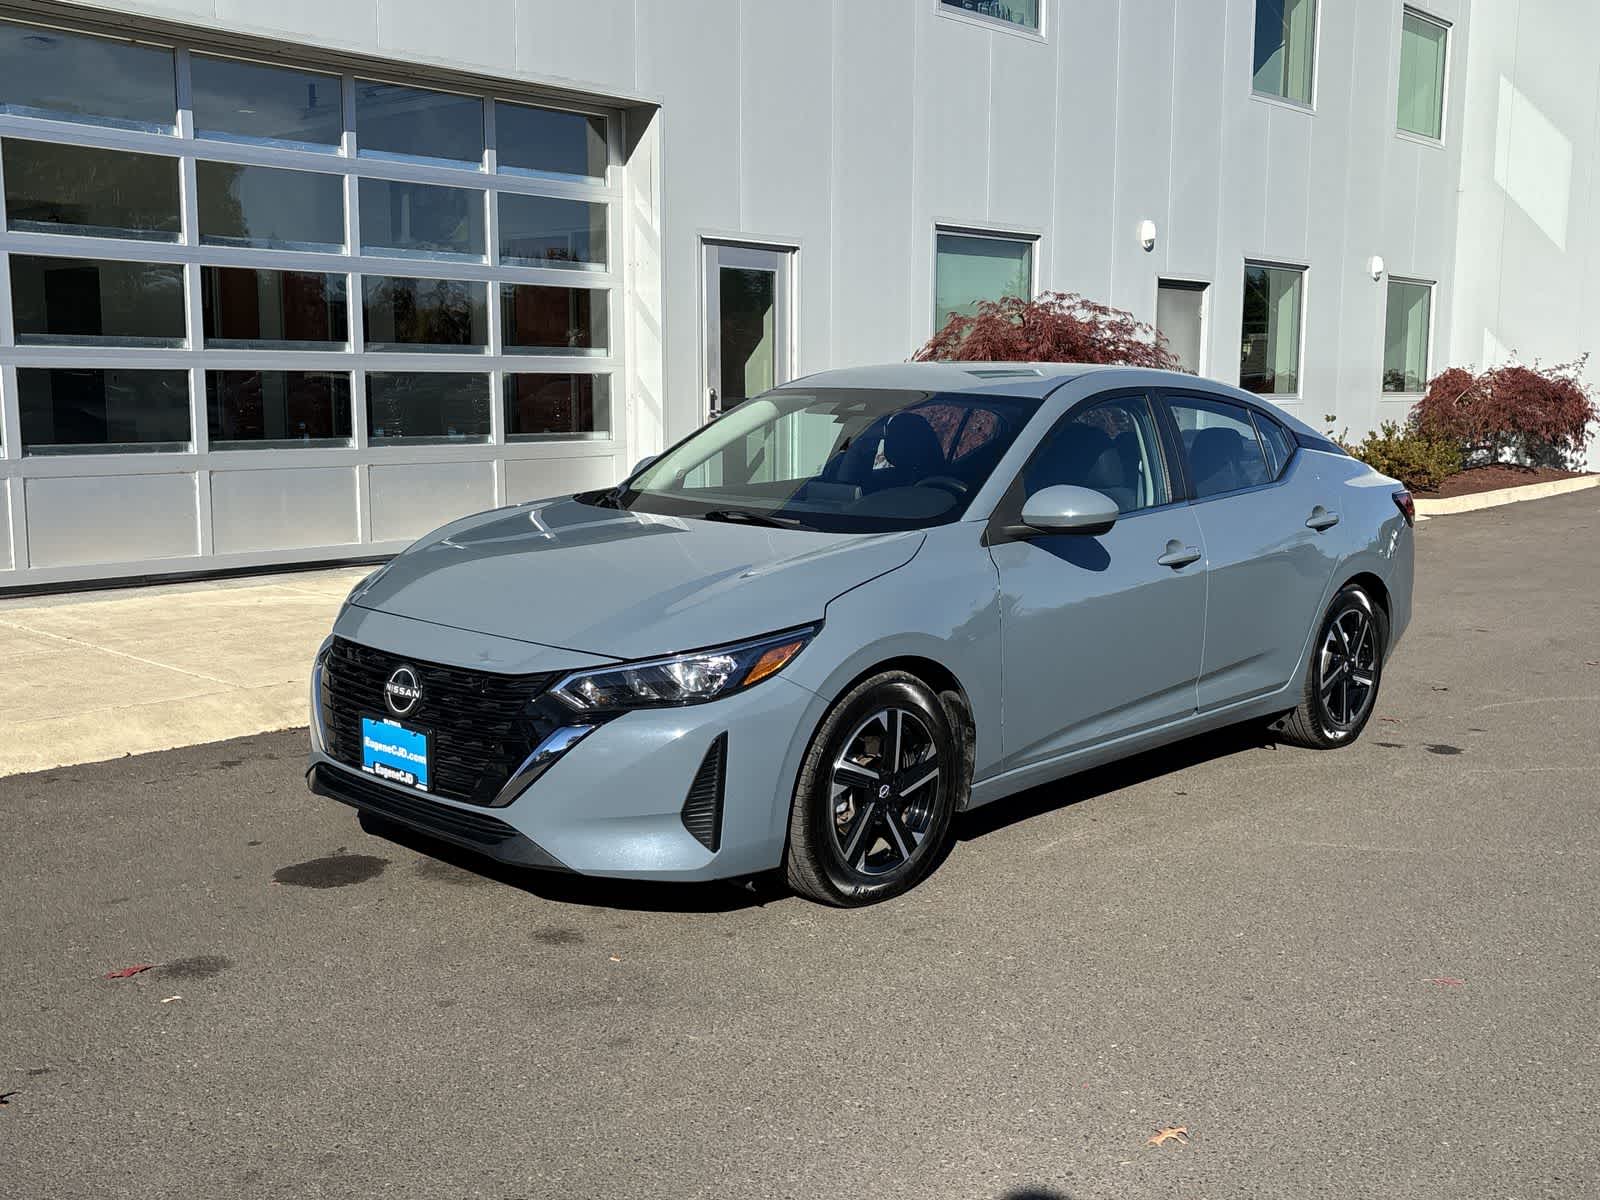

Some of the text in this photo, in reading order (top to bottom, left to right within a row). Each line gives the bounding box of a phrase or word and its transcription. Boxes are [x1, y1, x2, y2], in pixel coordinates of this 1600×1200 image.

[386, 683, 420, 698] NISSAN
[363, 736, 426, 764] EugeneCJD.com
[374, 763, 414, 785] EugeneCJD
